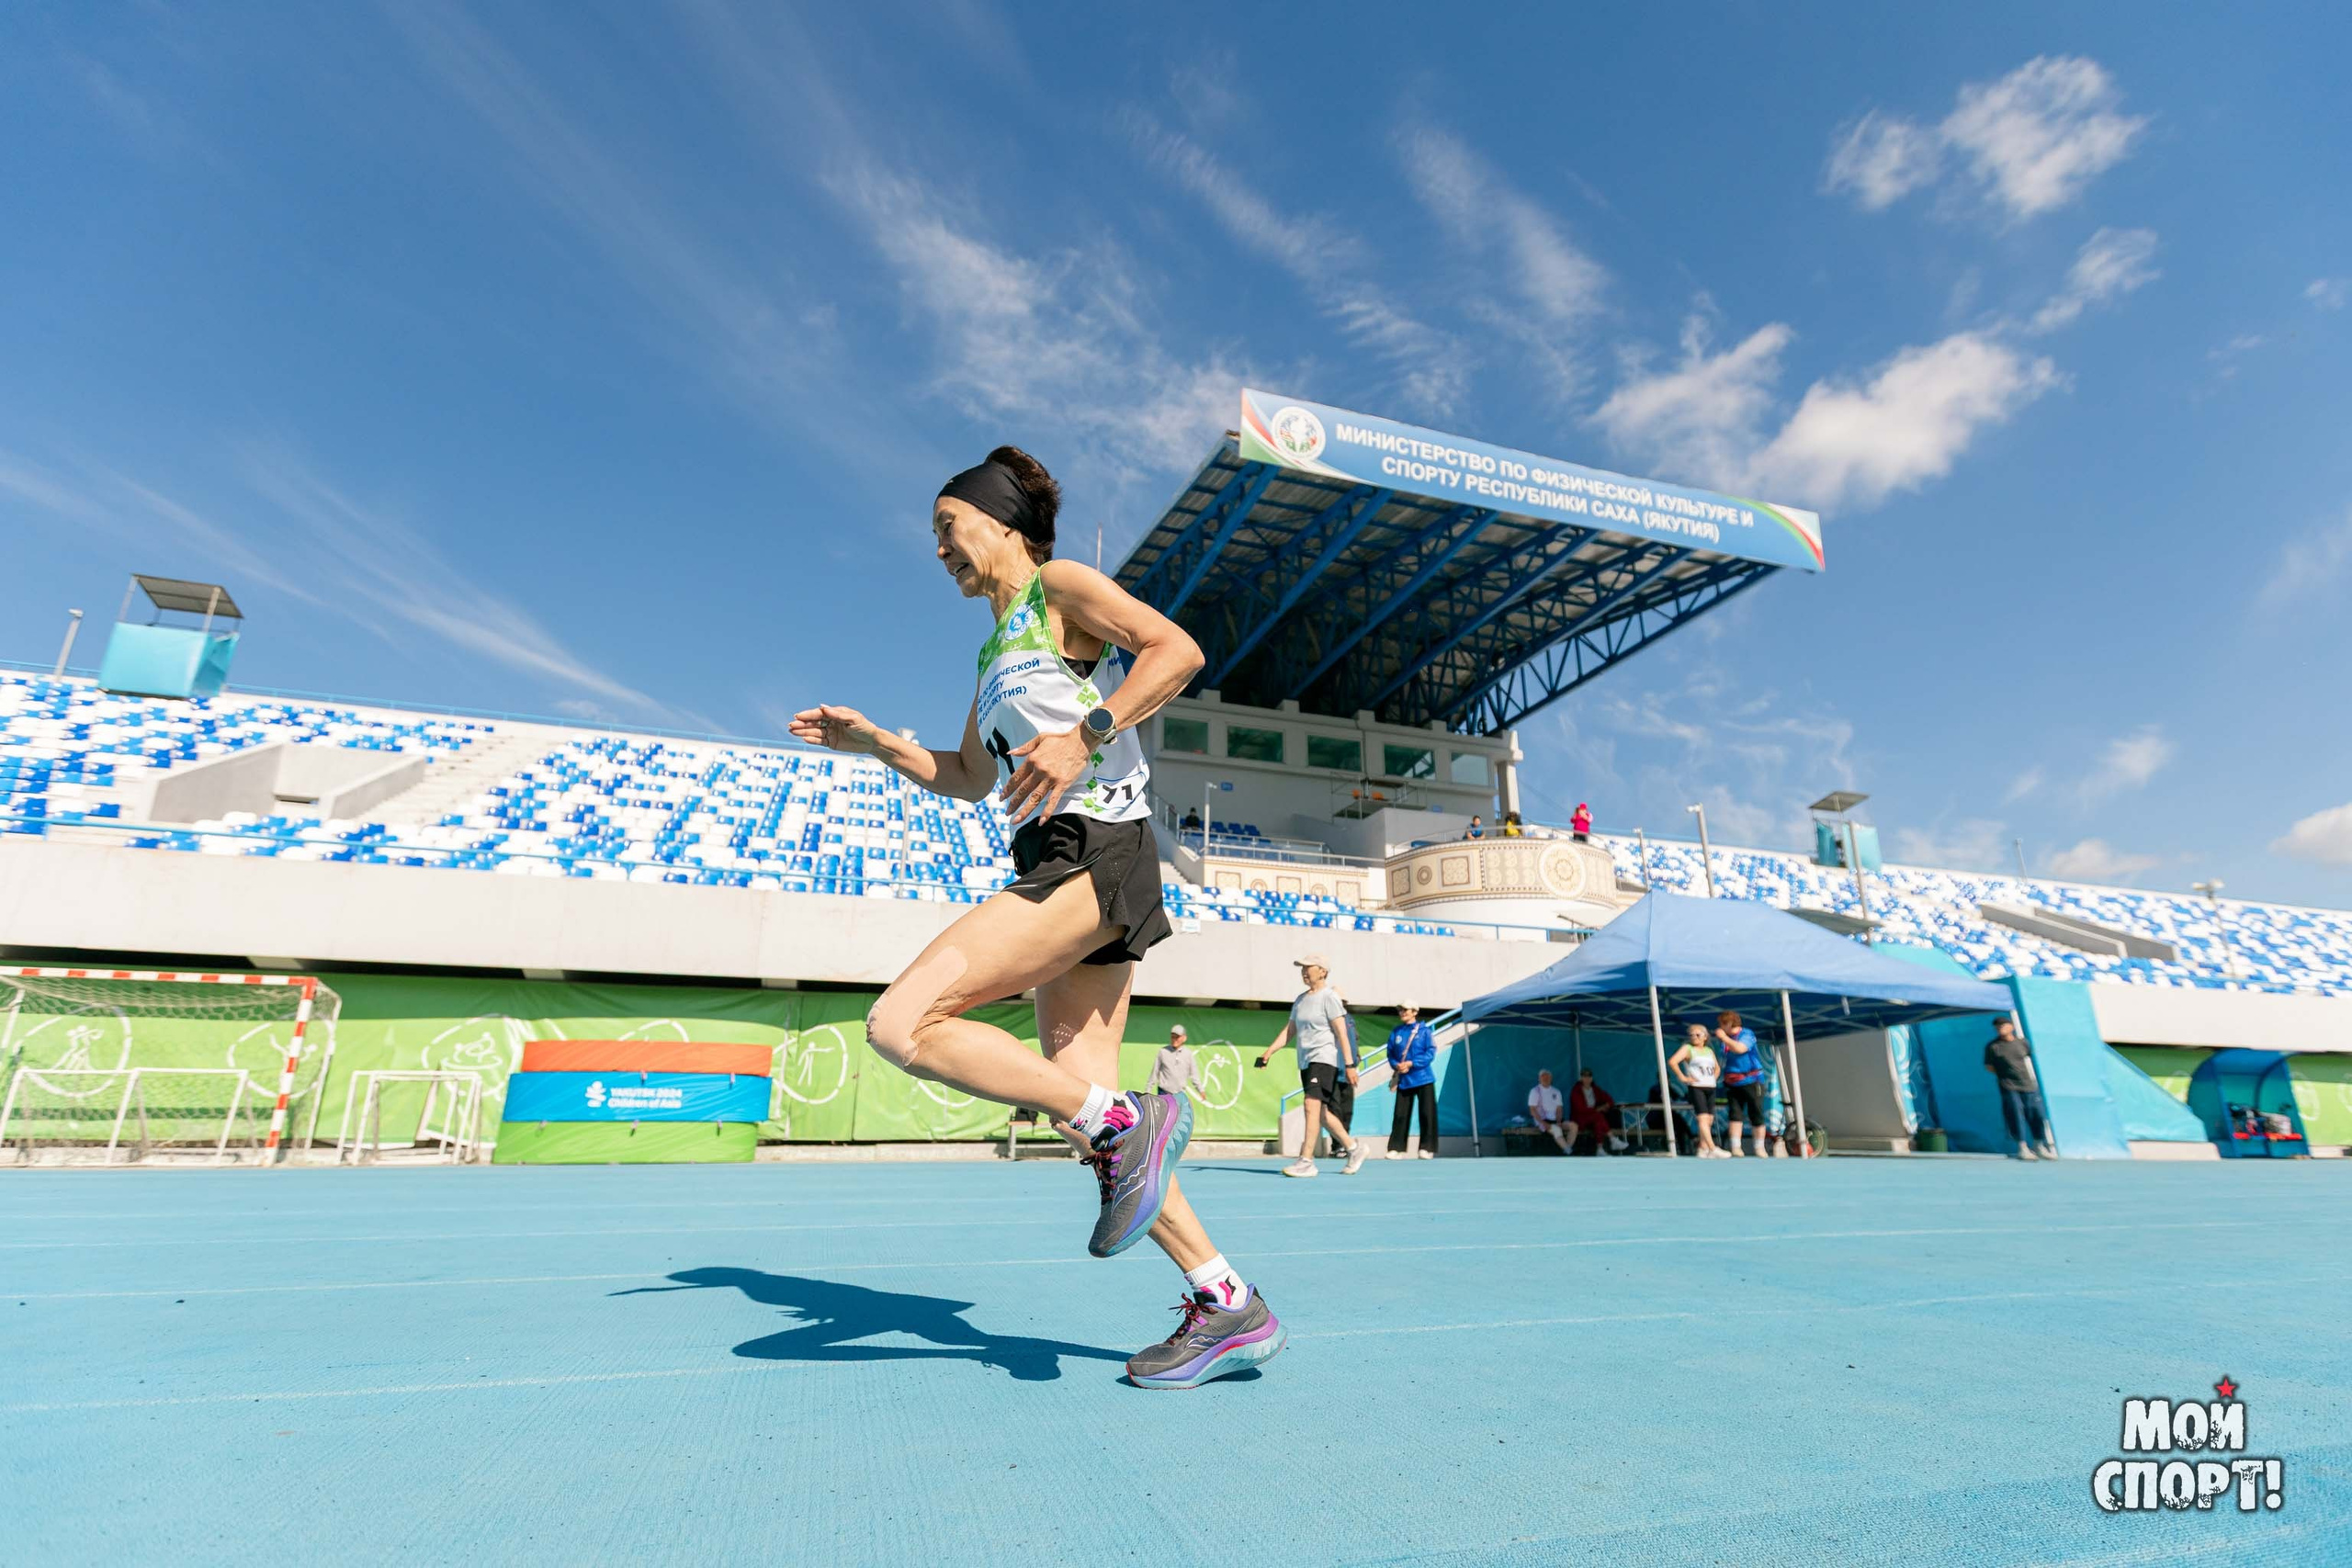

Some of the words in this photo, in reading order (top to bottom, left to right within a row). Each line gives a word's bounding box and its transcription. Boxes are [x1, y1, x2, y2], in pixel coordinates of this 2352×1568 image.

[1335, 423, 1496, 474] МИНИСТЕРСТВО
[1499, 460, 1528, 481] ПО
[1531, 468, 1653, 505] ФИЗИЧЕСКОЙ
[1655, 493, 1739, 525] КУЛЬТУРЕ
[1740, 511, 1755, 527] И
[1382, 457, 1462, 488] СПОРТУ
[1464, 474, 1588, 514] РЕСПУБЛИКИ
[1590, 500, 1640, 525] САХА
[1642, 511, 1721, 545] (ЯКУТИЯ)
[1102, 784, 1133, 804] 71
